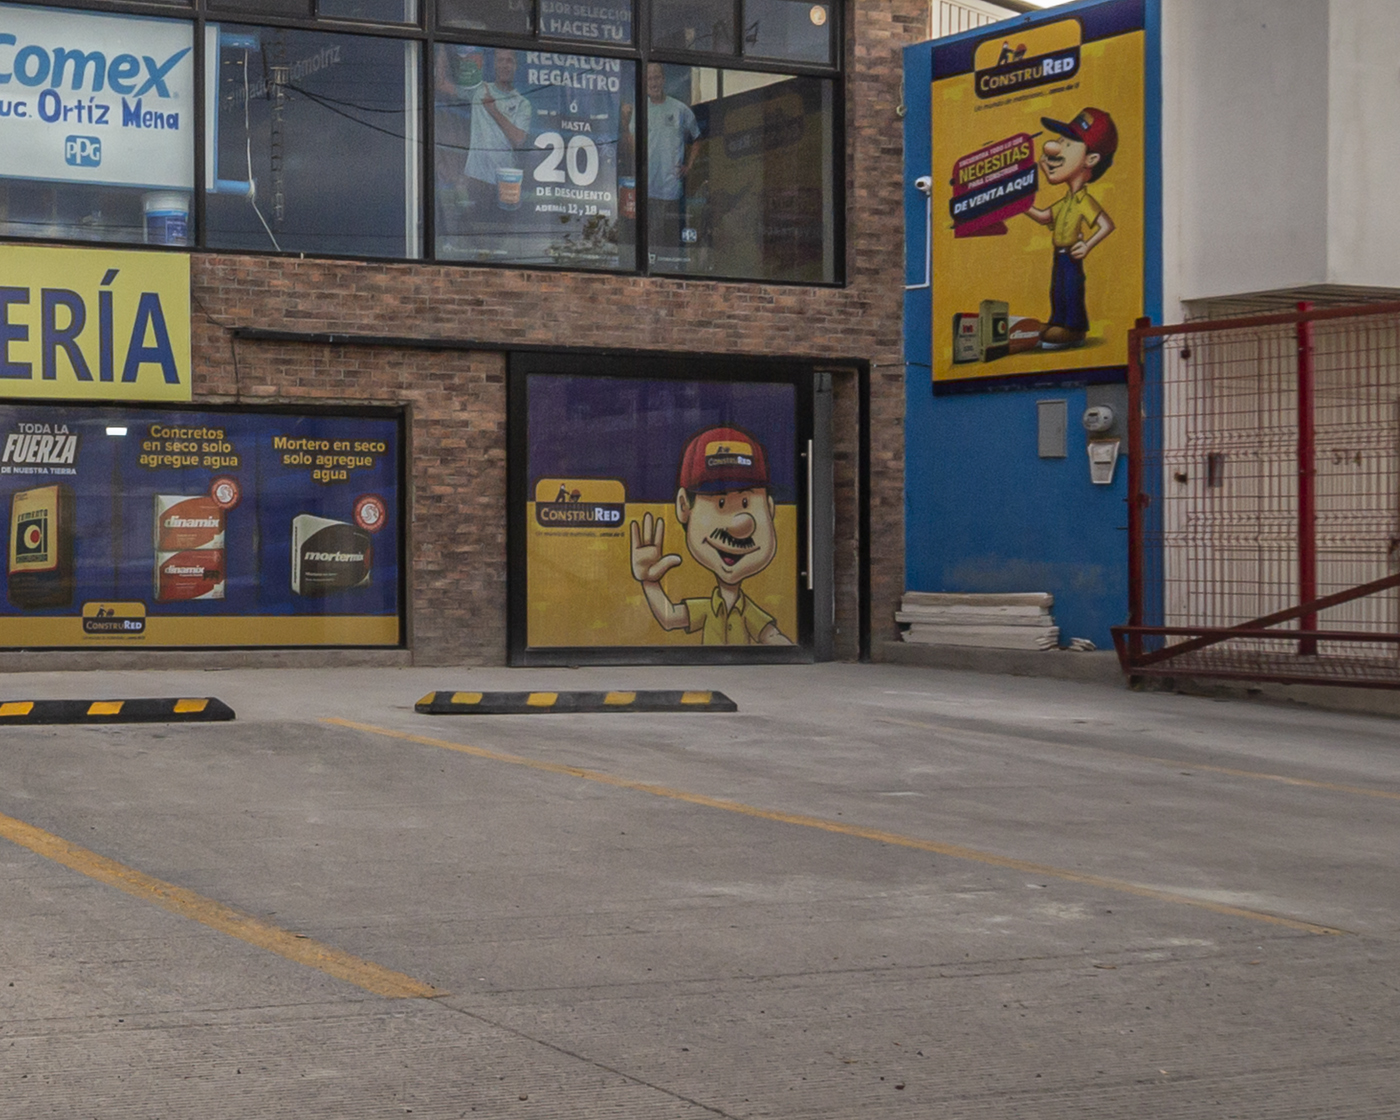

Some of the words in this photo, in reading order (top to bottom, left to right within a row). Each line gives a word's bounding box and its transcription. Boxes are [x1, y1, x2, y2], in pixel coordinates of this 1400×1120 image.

[550, 19, 599, 38] HACES
[528, 69, 620, 93] REGALITRO
[38, 88, 110, 125] Ortíz
[122, 97, 179, 130] Mena
[561, 120, 592, 132] HASTA
[67, 138, 100, 164] PPG
[533, 132, 599, 186] 20
[960, 142, 1030, 184] NECESITAS
[536, 187, 552, 196] DE
[554, 188, 612, 201] DESCUENTO
[954, 200, 968, 214] DE
[969, 185, 1004, 208] VENTA
[1005, 169, 1035, 193] AQUÍ
[19, 423, 50, 433] TODA
[54, 424, 69, 434] LA
[151, 425, 224, 440] Concretos
[2, 434, 77, 464] FUERZA
[143, 441, 161, 452] en
[165, 442, 198, 453] seco
[202, 440, 231, 453] solo
[274, 437, 329, 451] Mortero
[333, 440, 350, 451] en
[354, 441, 385, 453] seco
[140, 455, 199, 468] agregue
[203, 455, 238, 468] agua
[283, 452, 312, 465] solo
[315, 455, 372, 468] agregue
[1, 466, 12, 474] DE
[13, 467, 49, 475] NUESTRA
[313, 468, 347, 482] agua
[164, 515, 220, 528] dinamix
